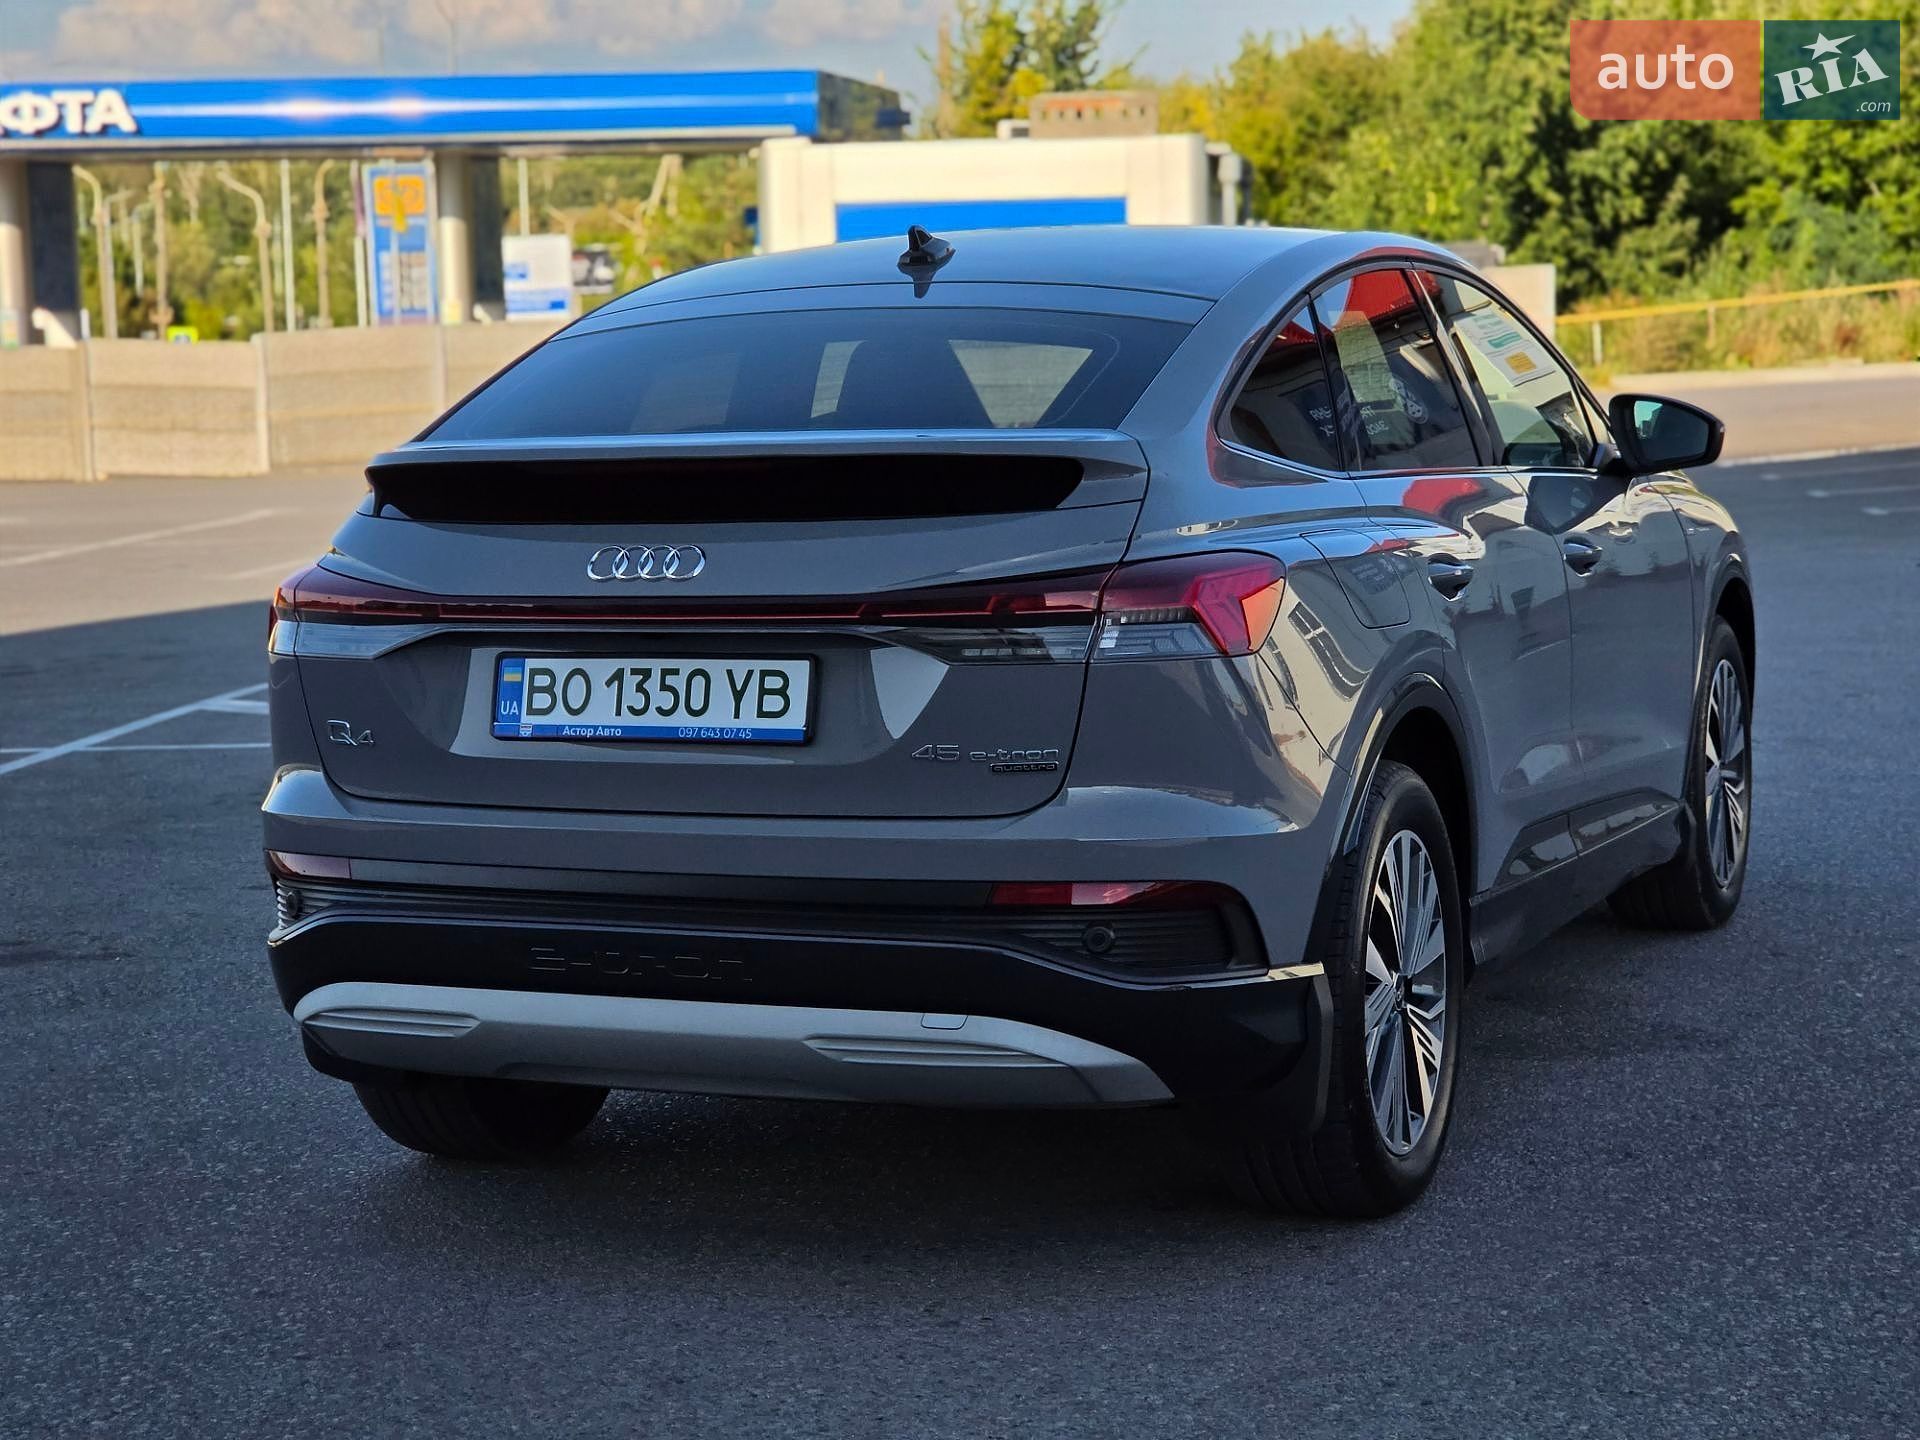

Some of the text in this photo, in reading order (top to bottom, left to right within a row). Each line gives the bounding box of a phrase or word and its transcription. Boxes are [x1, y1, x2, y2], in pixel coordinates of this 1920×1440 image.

[0, 89, 137, 135] ФТА
[526, 667, 791, 719] BO 1350 YB
[500, 700, 519, 716] UA
[328, 719, 374, 746] Q4
[562, 725, 622, 738] Астор Авто
[678, 727, 752, 740] 097 643 07 45
[911, 744, 1059, 761] 45 e-tron
[993, 763, 1056, 772] quattro
